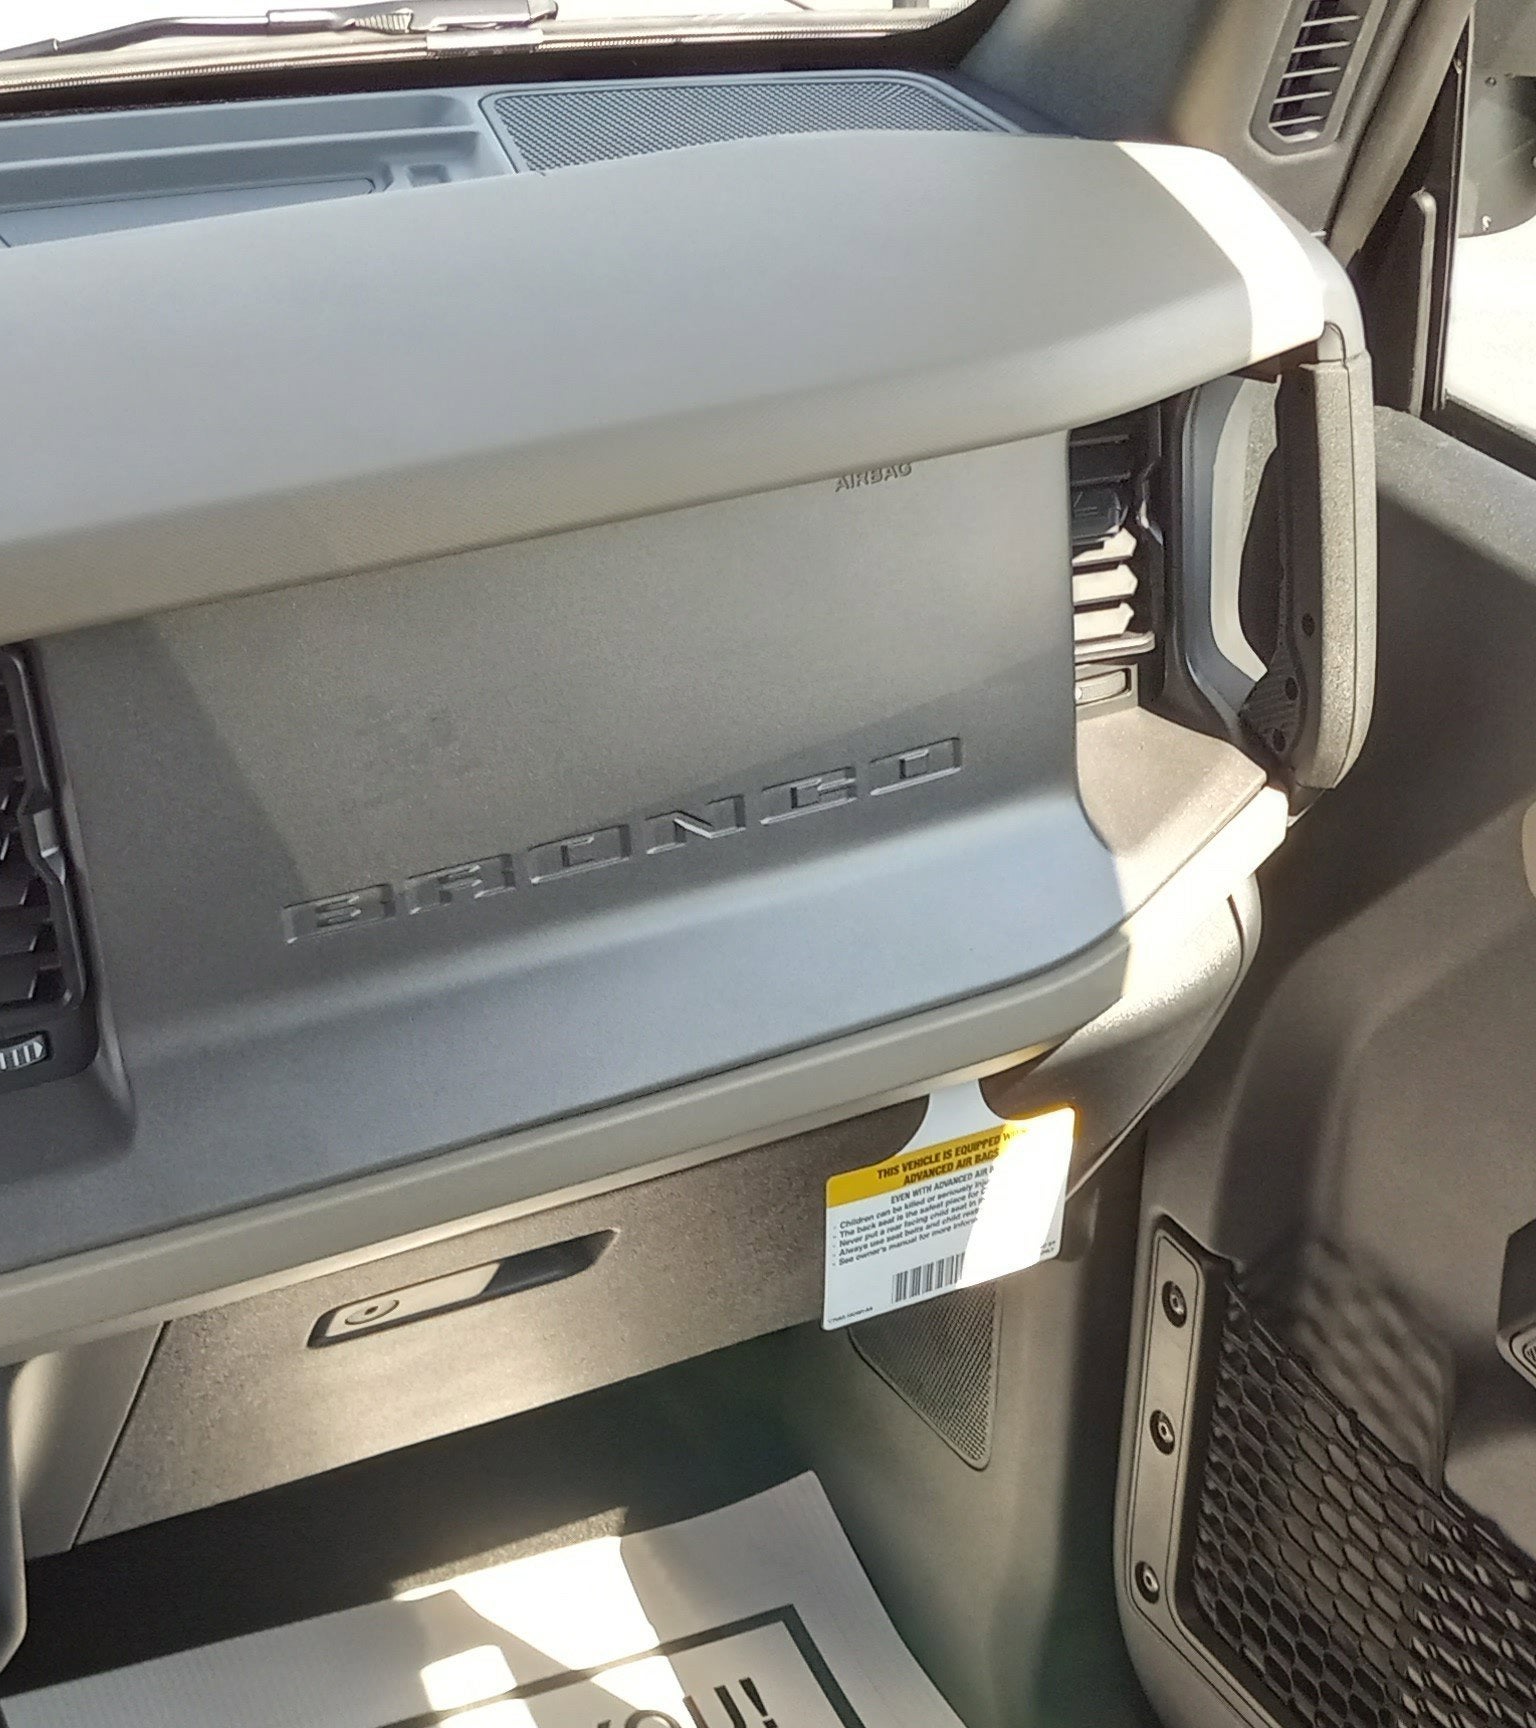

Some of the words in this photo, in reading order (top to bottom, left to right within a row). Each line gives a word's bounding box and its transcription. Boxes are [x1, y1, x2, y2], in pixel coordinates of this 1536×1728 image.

[834, 462, 914, 493] AIRBAG
[282, 735, 962, 945] BRONCO
[877, 1165, 901, 1180] THIS
[901, 1151, 941, 1172] VEHICLE
[942, 1148, 953, 1160] IS
[954, 1134, 1001, 1157] EQUIPPED
[903, 1162, 954, 1186] ADVANCED
[955, 1156, 973, 1169] AIR
[933, 1172, 973, 1191] ADVANCED
